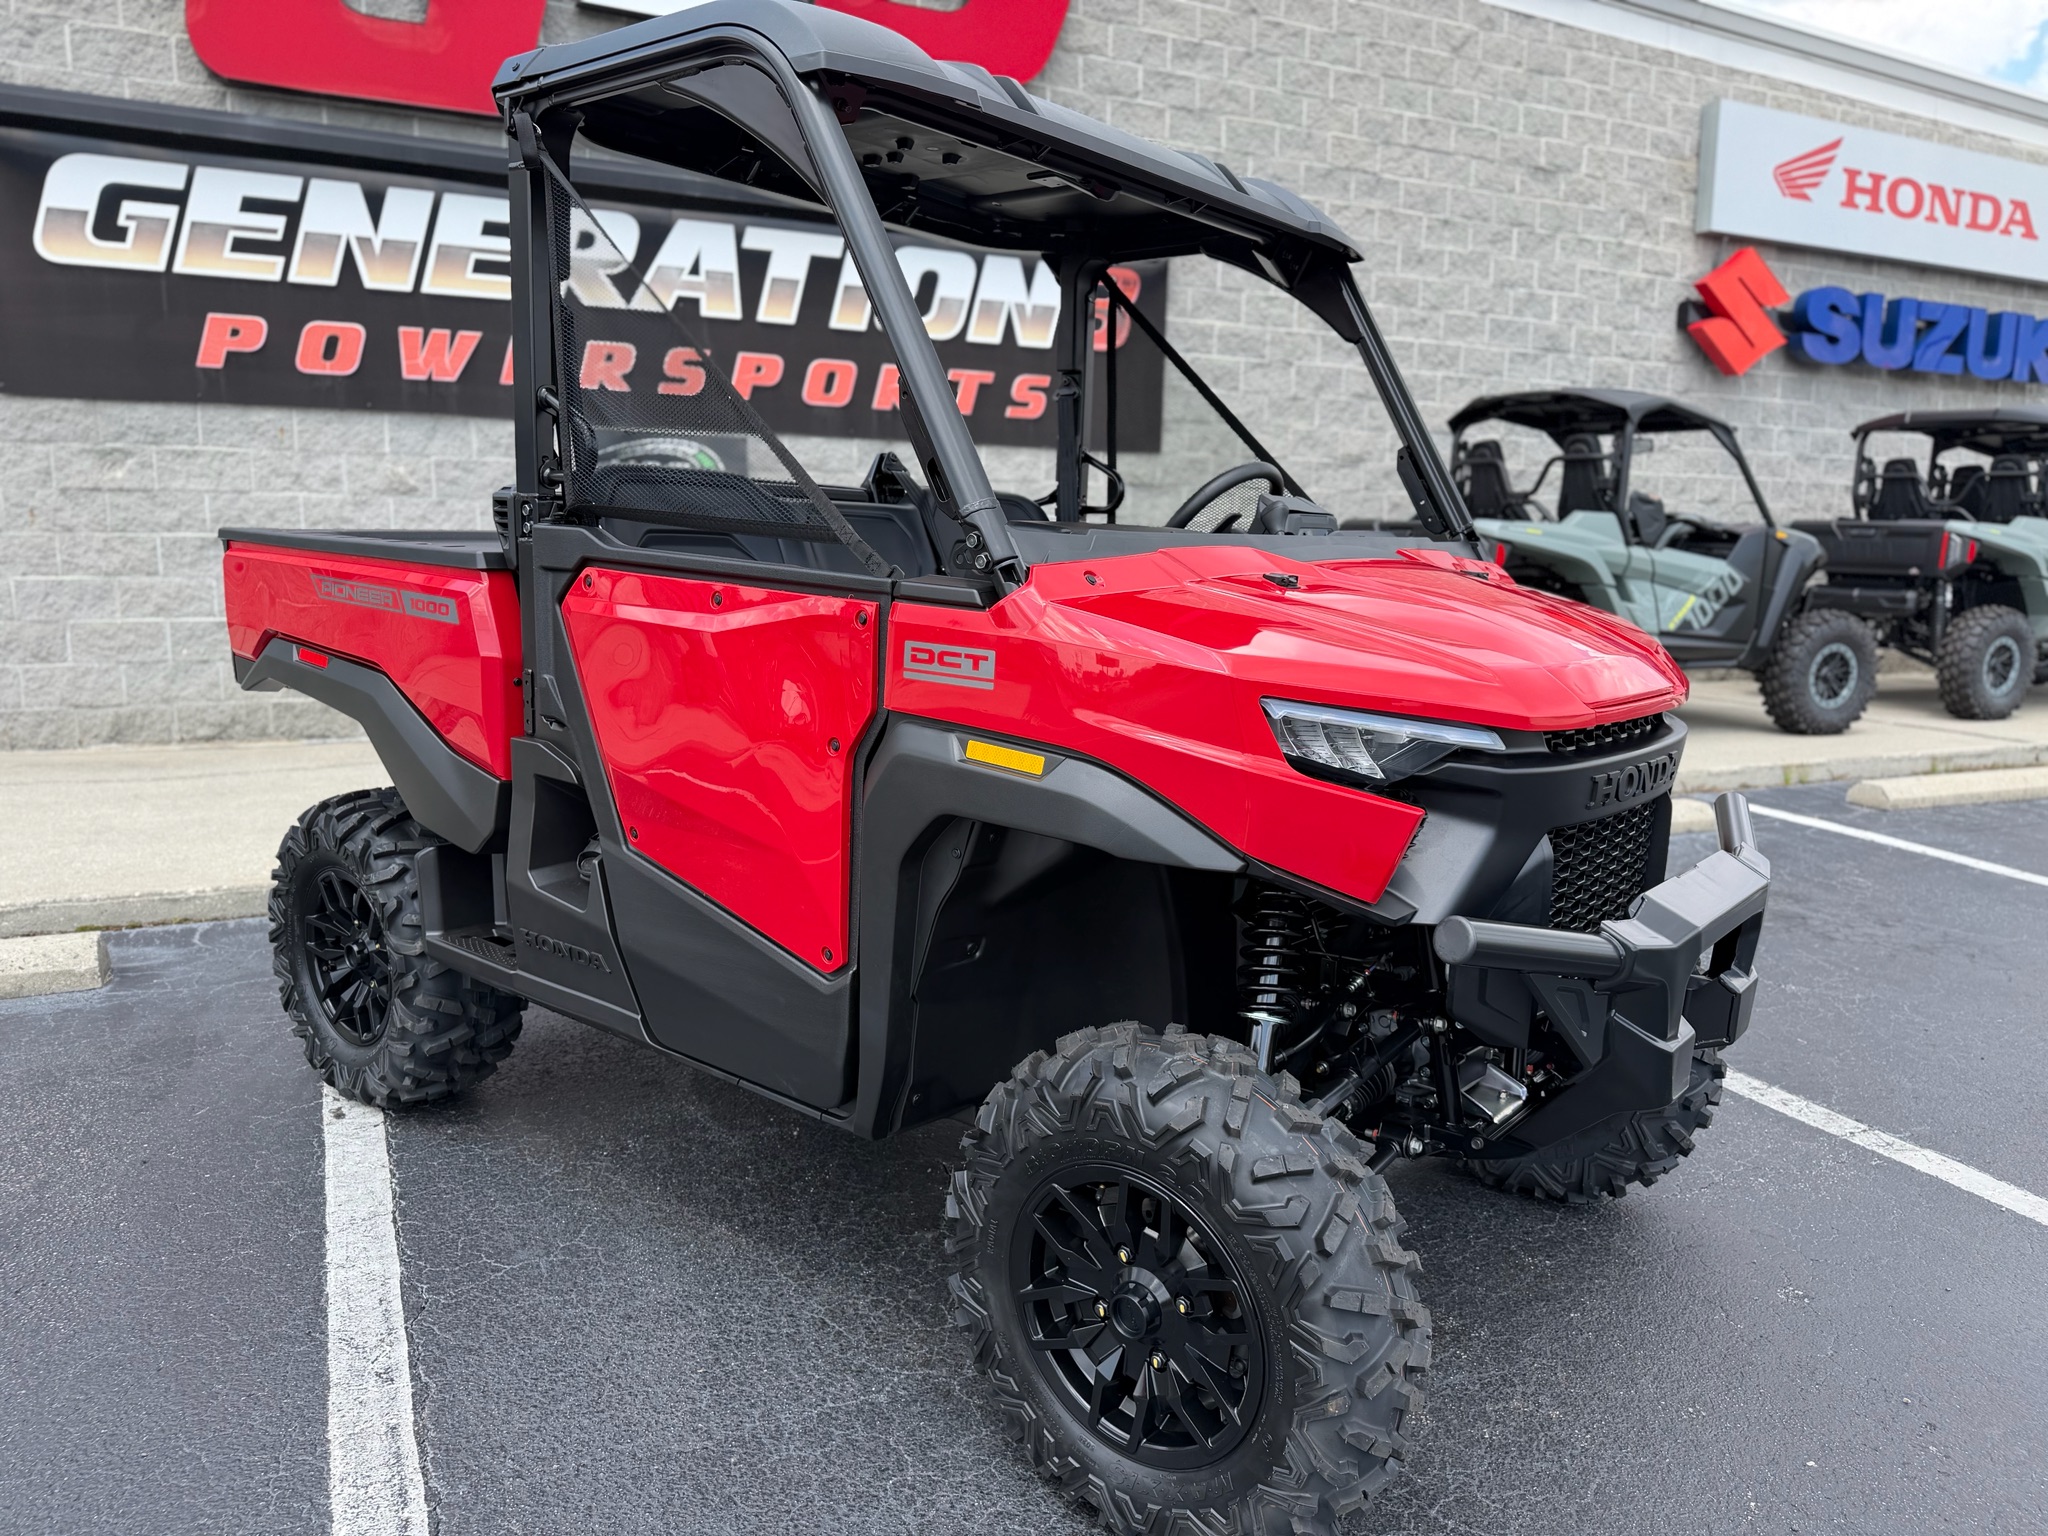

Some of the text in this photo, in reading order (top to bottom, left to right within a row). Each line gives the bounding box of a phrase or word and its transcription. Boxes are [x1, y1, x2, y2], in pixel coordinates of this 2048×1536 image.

[1840, 166, 2039, 241] HONDA
[33, 152, 1062, 349] GENERATION
[196, 312, 1052, 420] POWRSPORTS
[321, 581, 450, 617] PIONEER 1000
[910, 646, 989, 671] DCT
[1586, 750, 1679, 810] HONDA
[519, 927, 612, 975] HONDA
